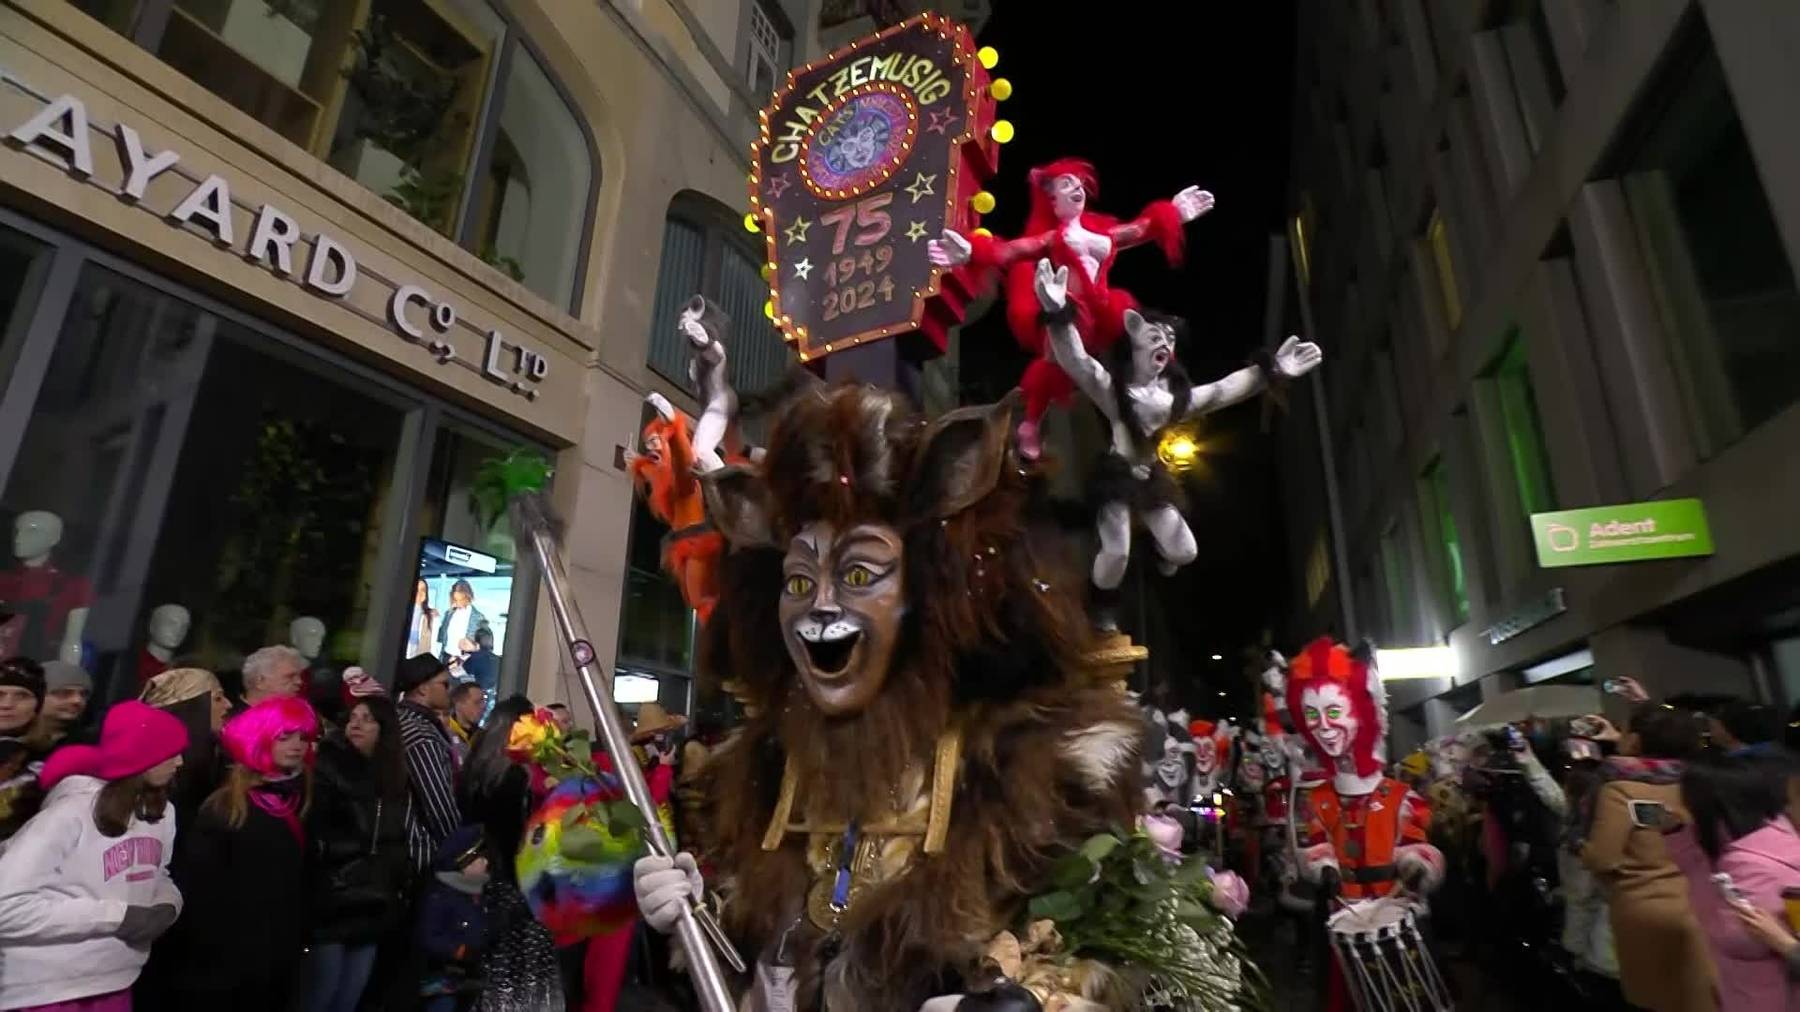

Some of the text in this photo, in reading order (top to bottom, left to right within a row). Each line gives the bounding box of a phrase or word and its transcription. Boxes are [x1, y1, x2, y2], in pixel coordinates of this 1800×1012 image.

[771, 52, 952, 163] CHATZEMUSIG
[820, 191, 894, 255] 75
[825, 244, 894, 288] 1949
[821, 274, 896, 321] 2024
[1589, 517, 1656, 538] Adent
